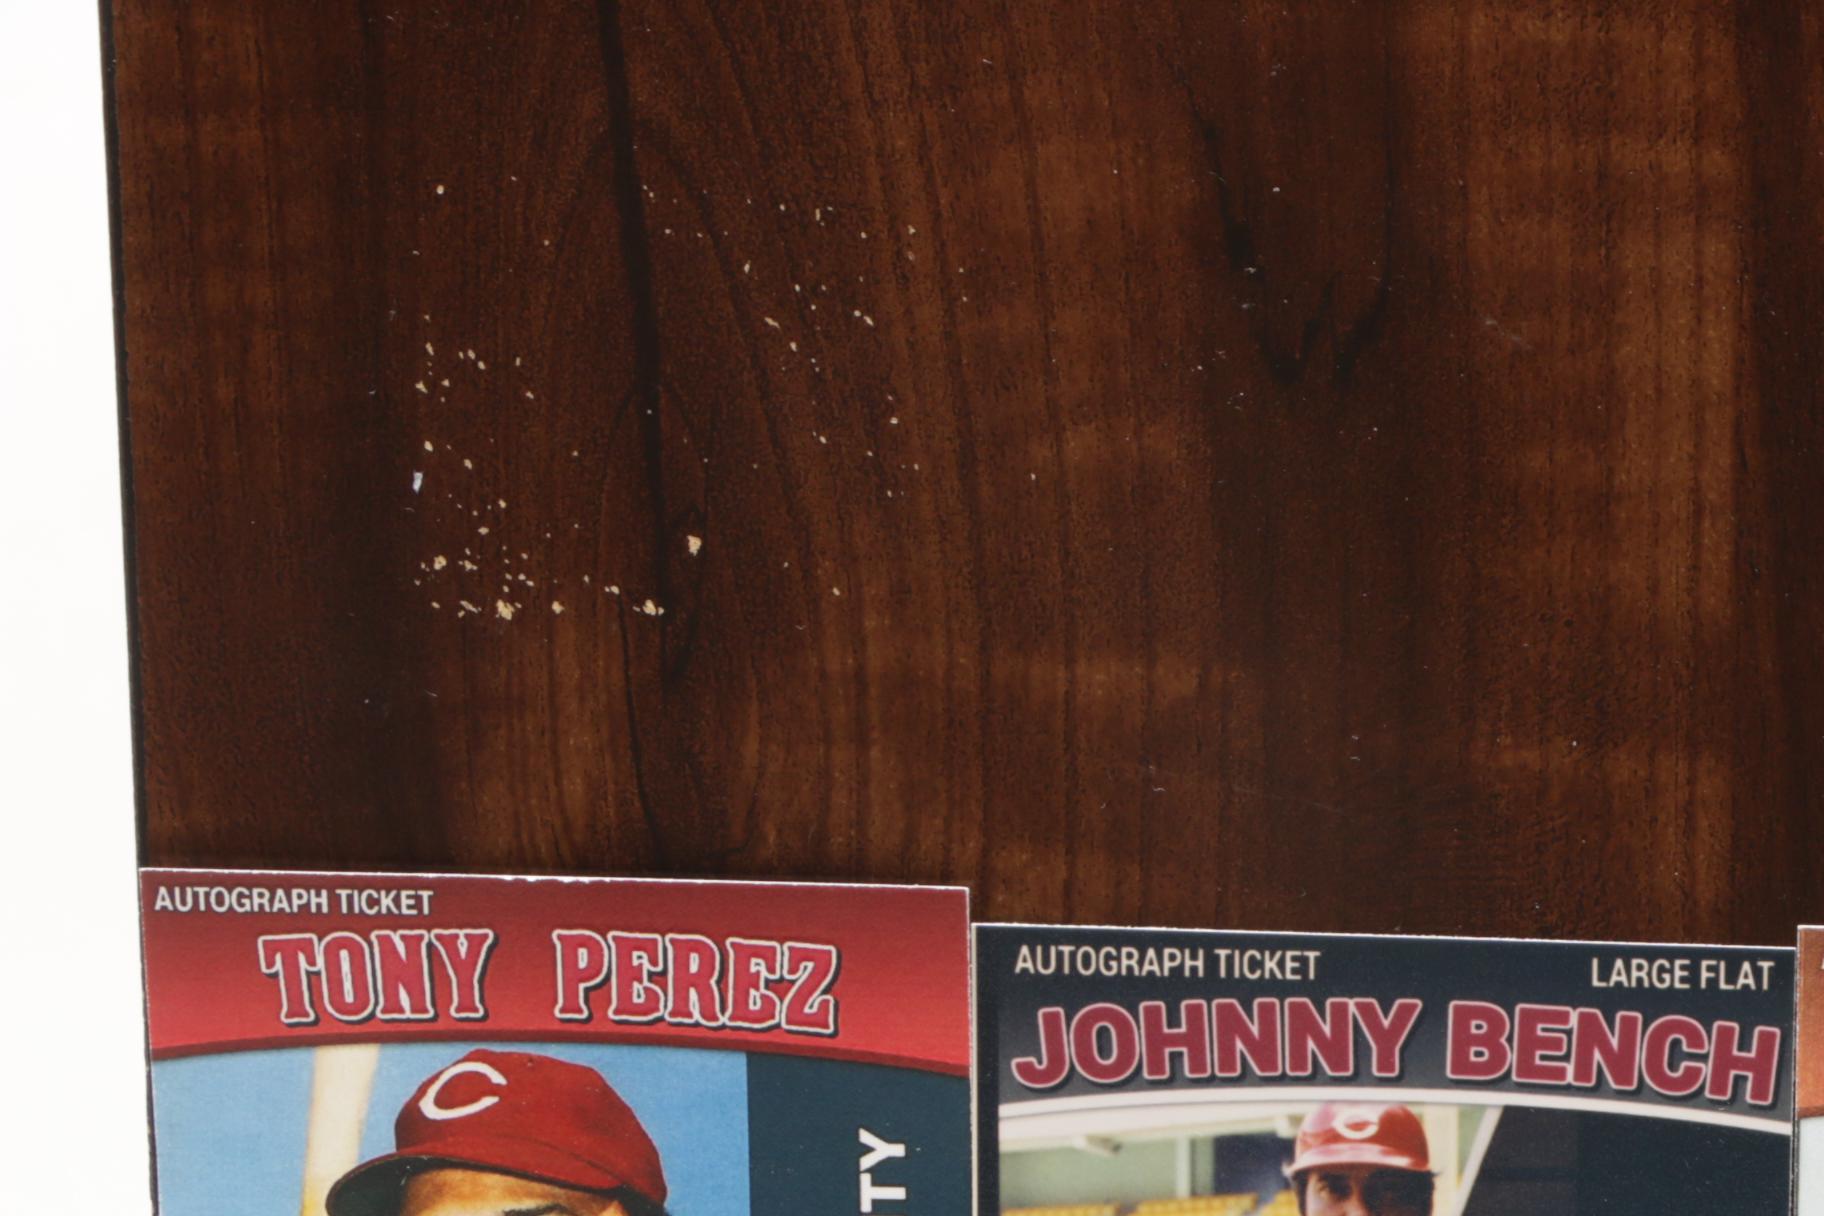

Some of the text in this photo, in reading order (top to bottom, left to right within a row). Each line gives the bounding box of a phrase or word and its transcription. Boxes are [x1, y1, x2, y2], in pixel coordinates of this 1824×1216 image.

[154, 886, 434, 916] AUTOGRAPH TICKET
[259, 929, 839, 1034] TONY PEREZ
[1014, 944, 1321, 981] AUTOGRAPH TICKET
[1591, 957, 1775, 991] LARGE FLAT
[1011, 998, 1783, 1107] JOHNNY BENCH
[418, 1061, 508, 1121] C
